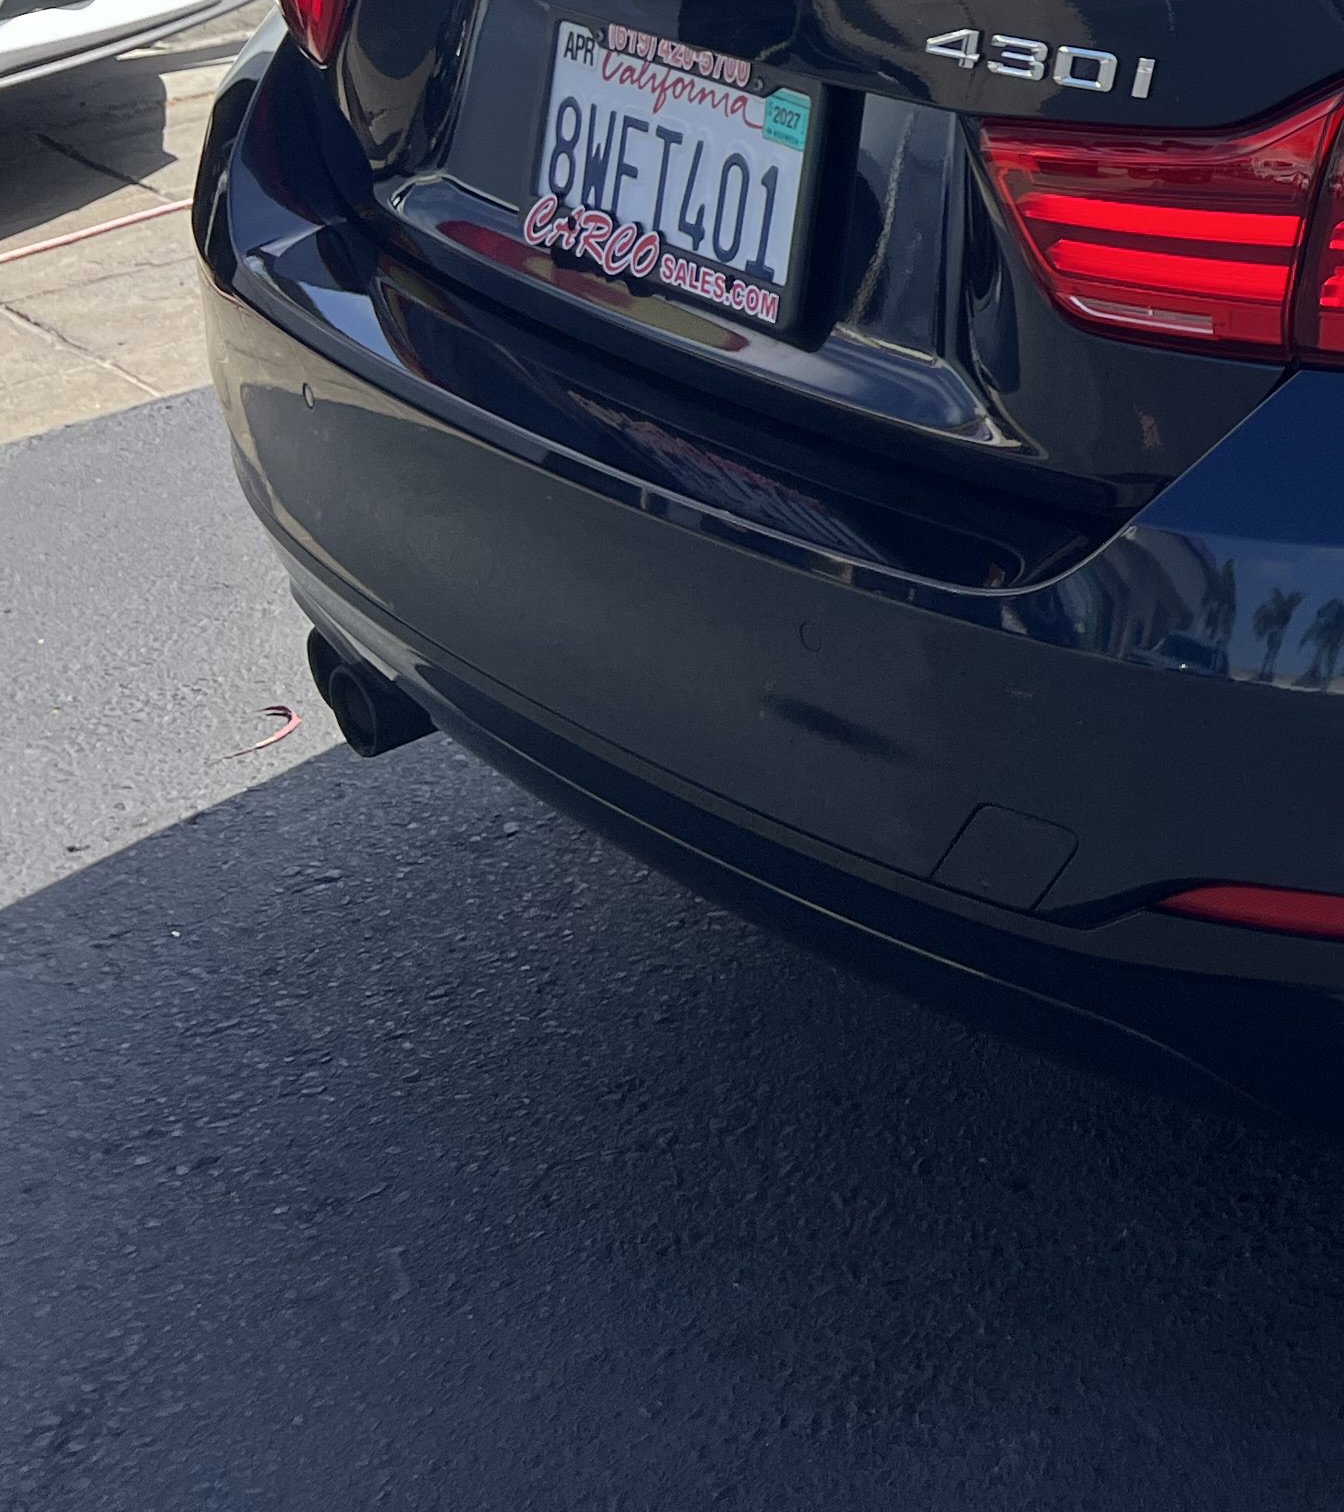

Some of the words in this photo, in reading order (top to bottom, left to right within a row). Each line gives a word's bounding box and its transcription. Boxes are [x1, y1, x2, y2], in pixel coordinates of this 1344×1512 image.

[563, 31, 596, 66] APR
[602, 49, 764, 130] California
[548, 96, 780, 283] 8WFT401
[523, 194, 661, 278] CARCO
[660, 253, 780, 324] SALES.COM
